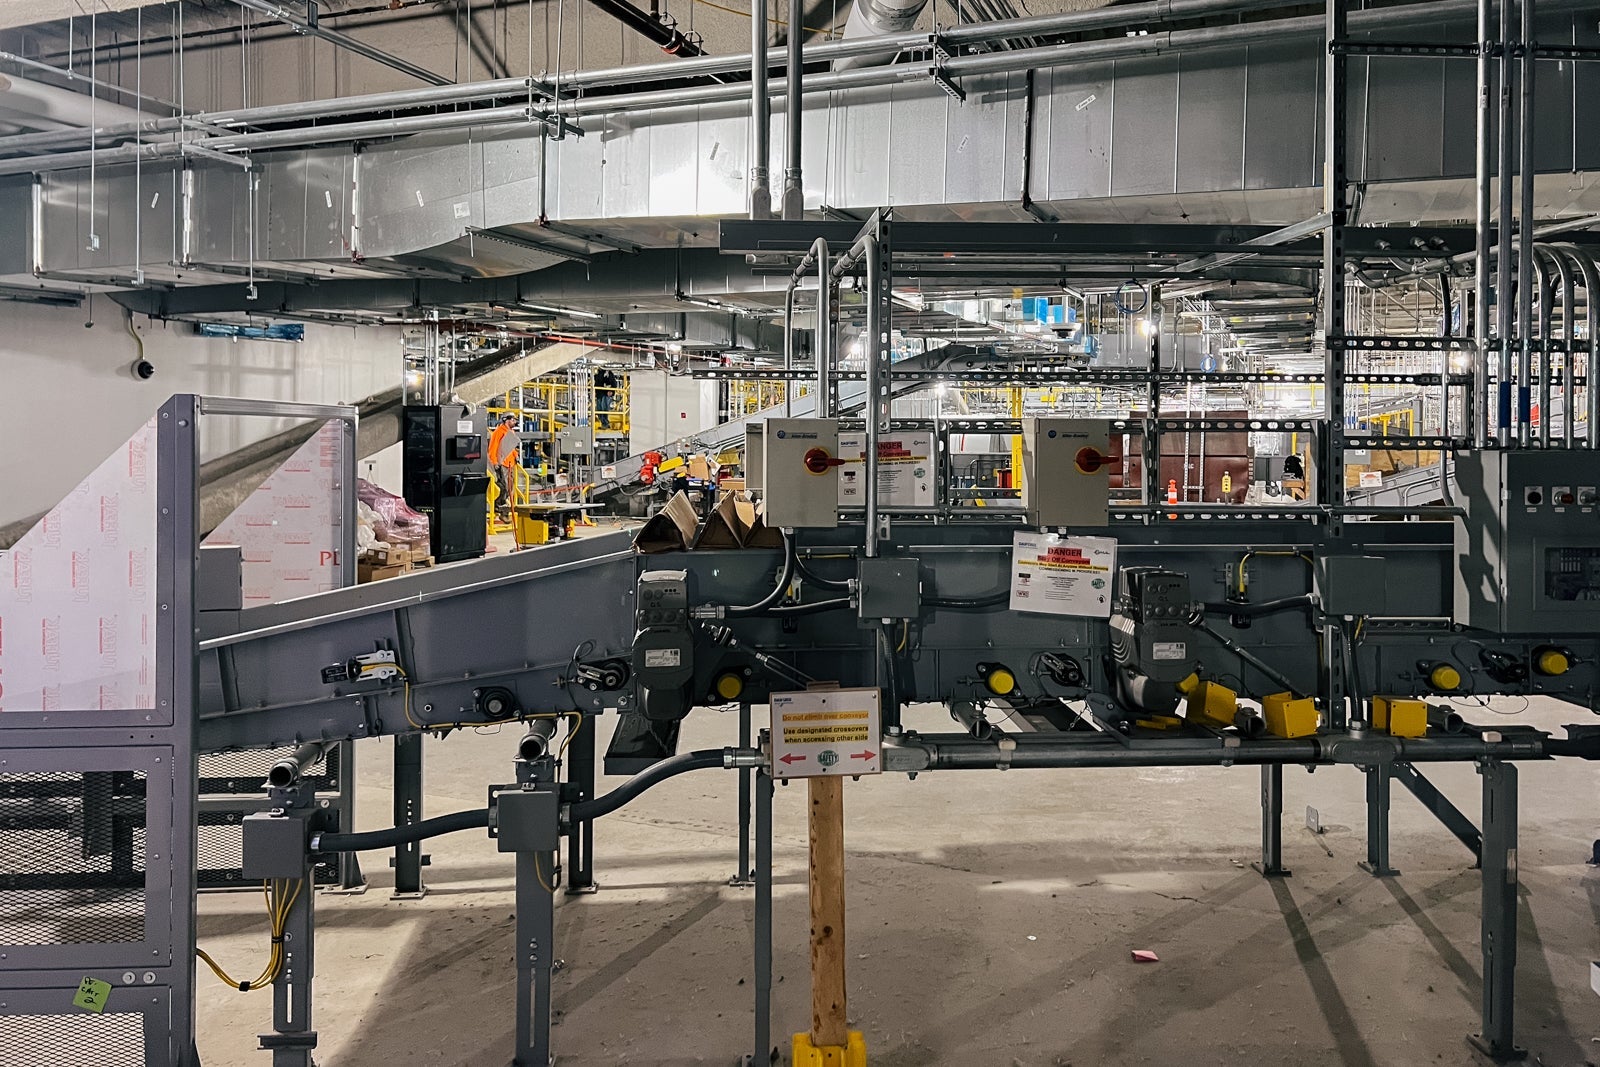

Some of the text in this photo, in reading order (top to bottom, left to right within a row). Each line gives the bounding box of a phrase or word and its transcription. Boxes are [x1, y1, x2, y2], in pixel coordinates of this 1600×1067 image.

[1048, 548, 1082, 557] DANGER
[783, 725, 869, 735] Use designated crossovers
[803, 736, 835, 744] accessing
